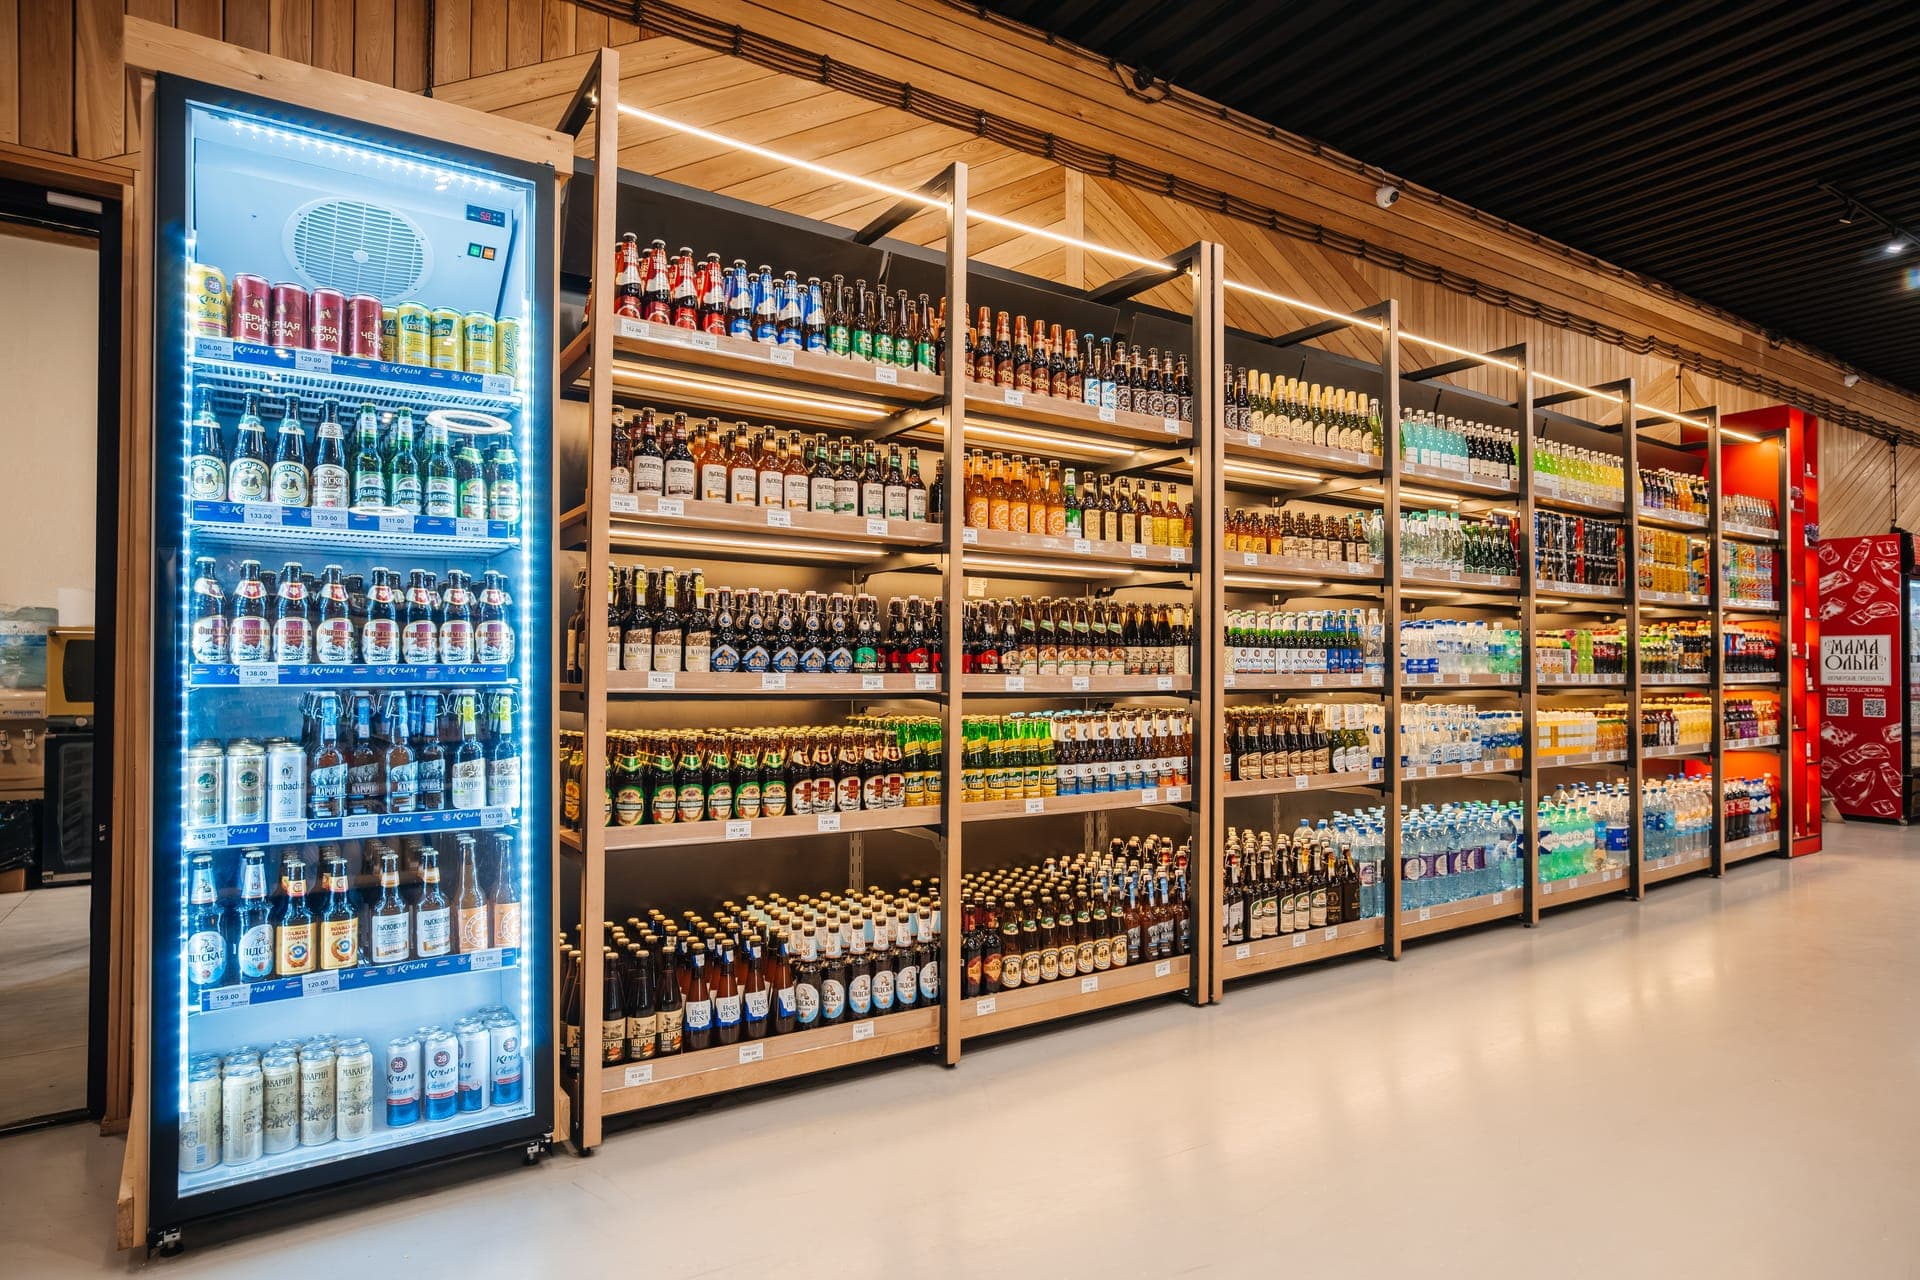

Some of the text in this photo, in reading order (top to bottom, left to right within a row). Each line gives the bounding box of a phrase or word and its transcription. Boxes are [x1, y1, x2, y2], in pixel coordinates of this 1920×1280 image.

[199, 343, 222, 352] 106.00
[300, 355, 322, 364] 129.00
[250, 513, 272, 521] 133.00
[317, 514, 338, 522] 139.00
[1830, 639, 1879, 654] МАМА
[1825, 655, 1879, 670] ОЛЬГА
[348, 820, 369, 829] 221.00
[308, 979, 329, 989] 120.00
[216, 993, 240, 1002] 159.00
